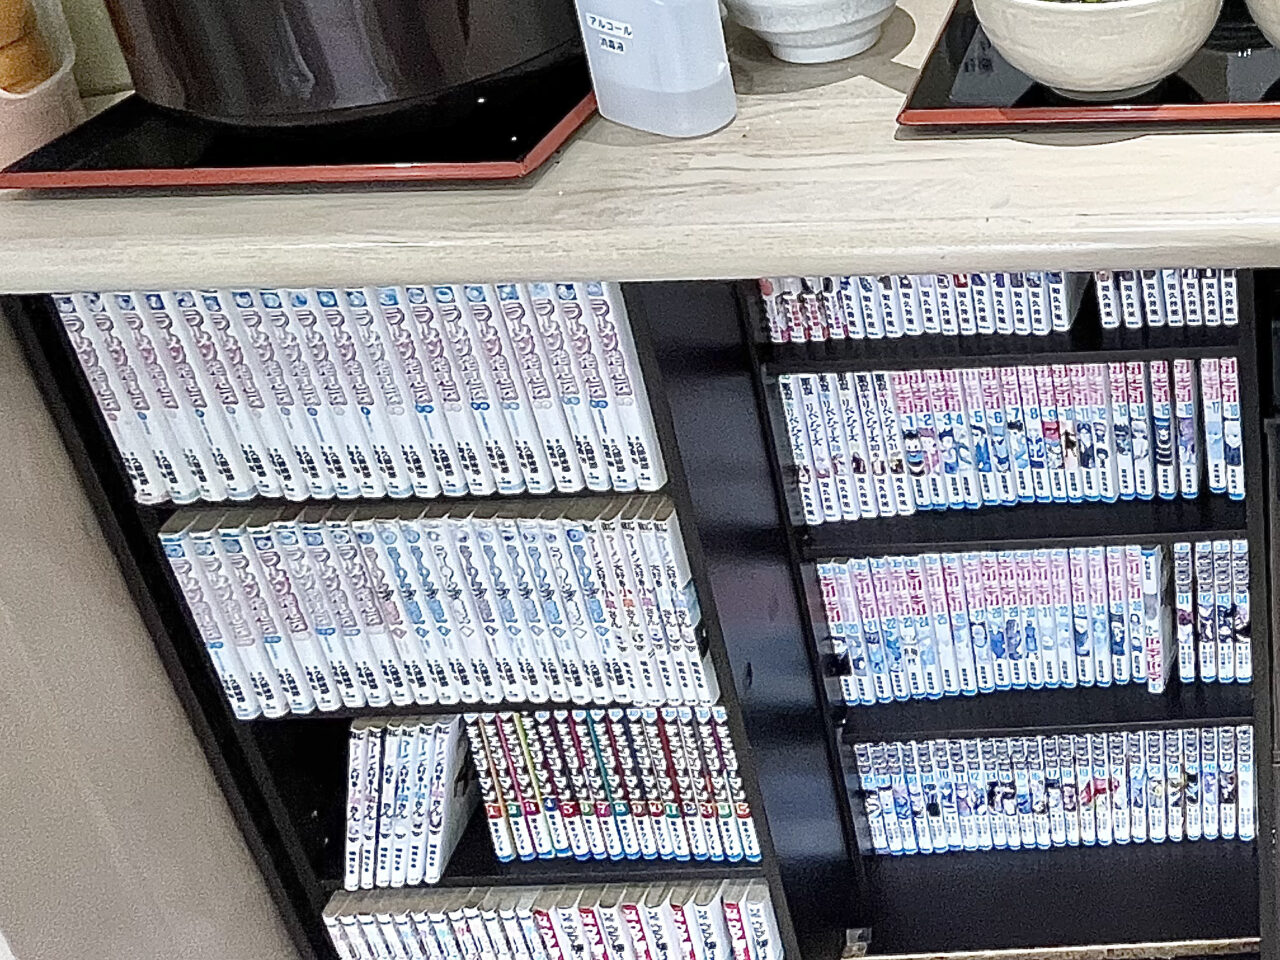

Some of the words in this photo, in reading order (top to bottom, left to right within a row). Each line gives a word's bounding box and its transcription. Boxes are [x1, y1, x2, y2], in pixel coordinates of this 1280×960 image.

[589, 16, 632, 35] アルコール
